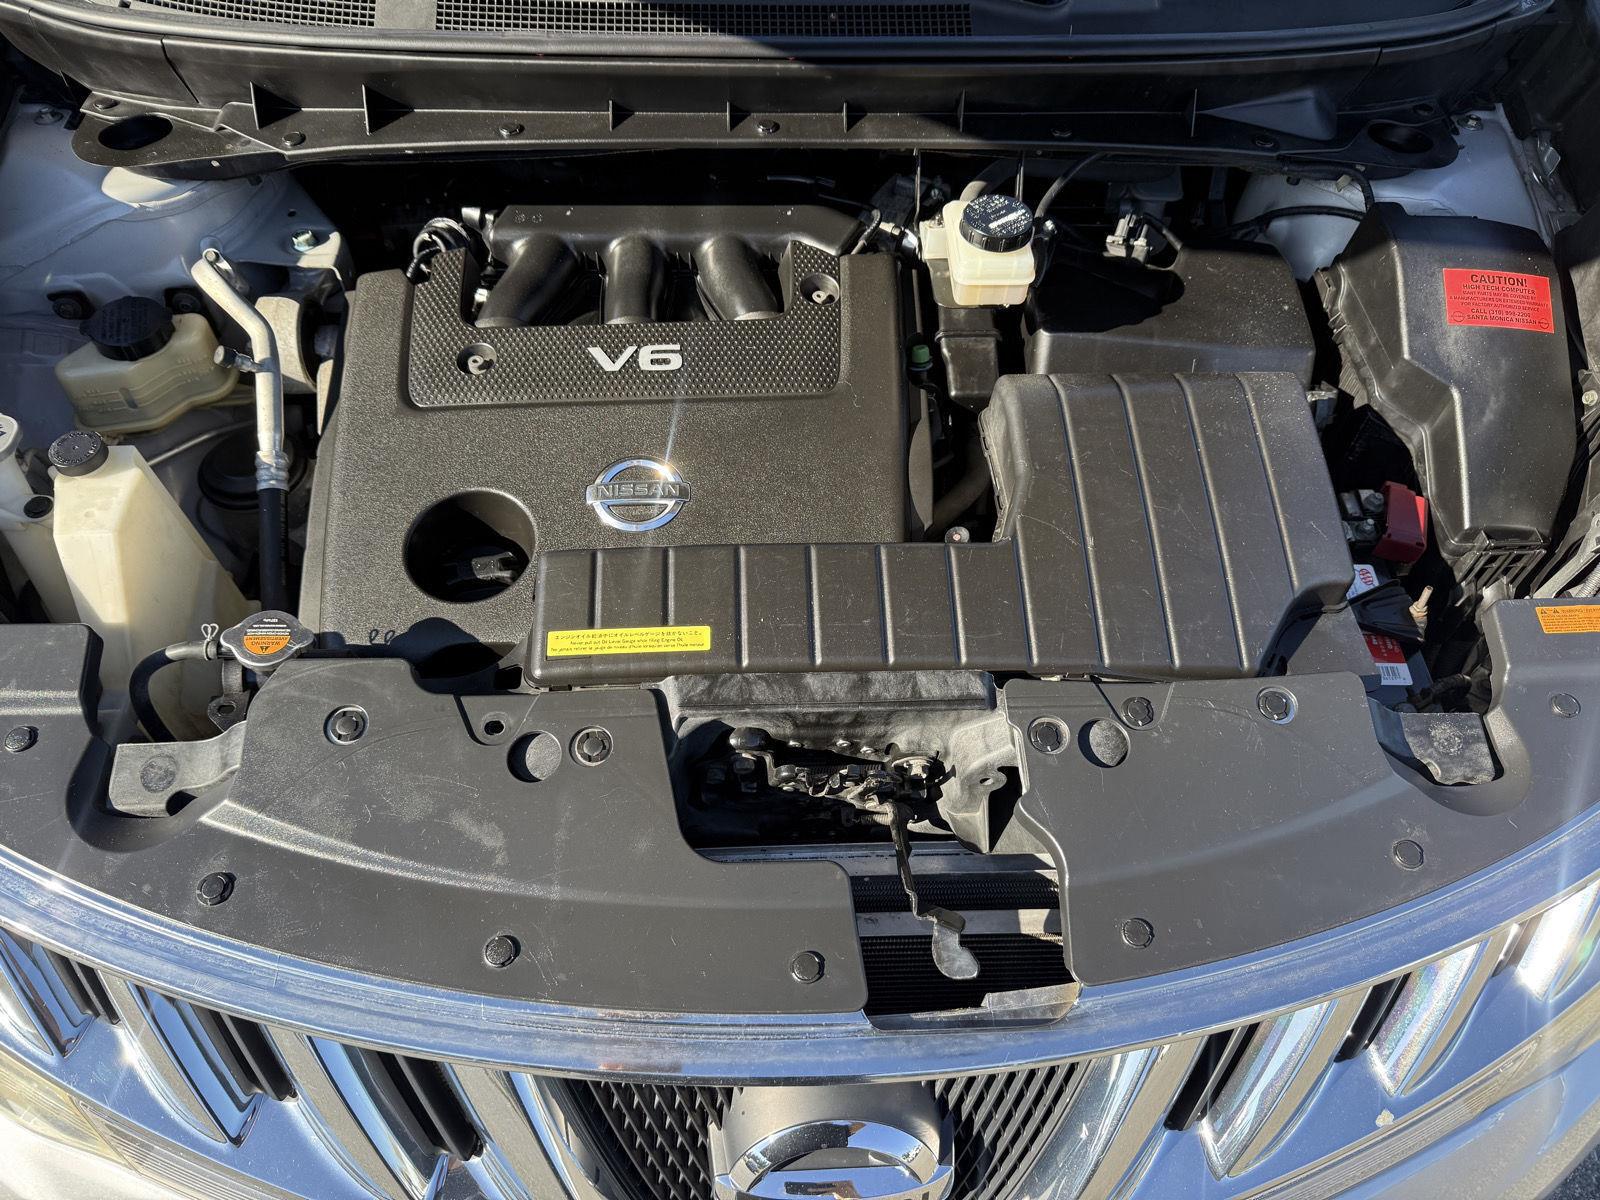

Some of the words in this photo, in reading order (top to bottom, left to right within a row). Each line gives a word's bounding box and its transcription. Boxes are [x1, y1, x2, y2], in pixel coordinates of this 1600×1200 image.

[1470, 274, 1527, 287] CAUTION!
[1501, 286, 1535, 295] COMPUTER
[587, 344, 683, 372] V6
[597, 484, 681, 497] NISSAN
